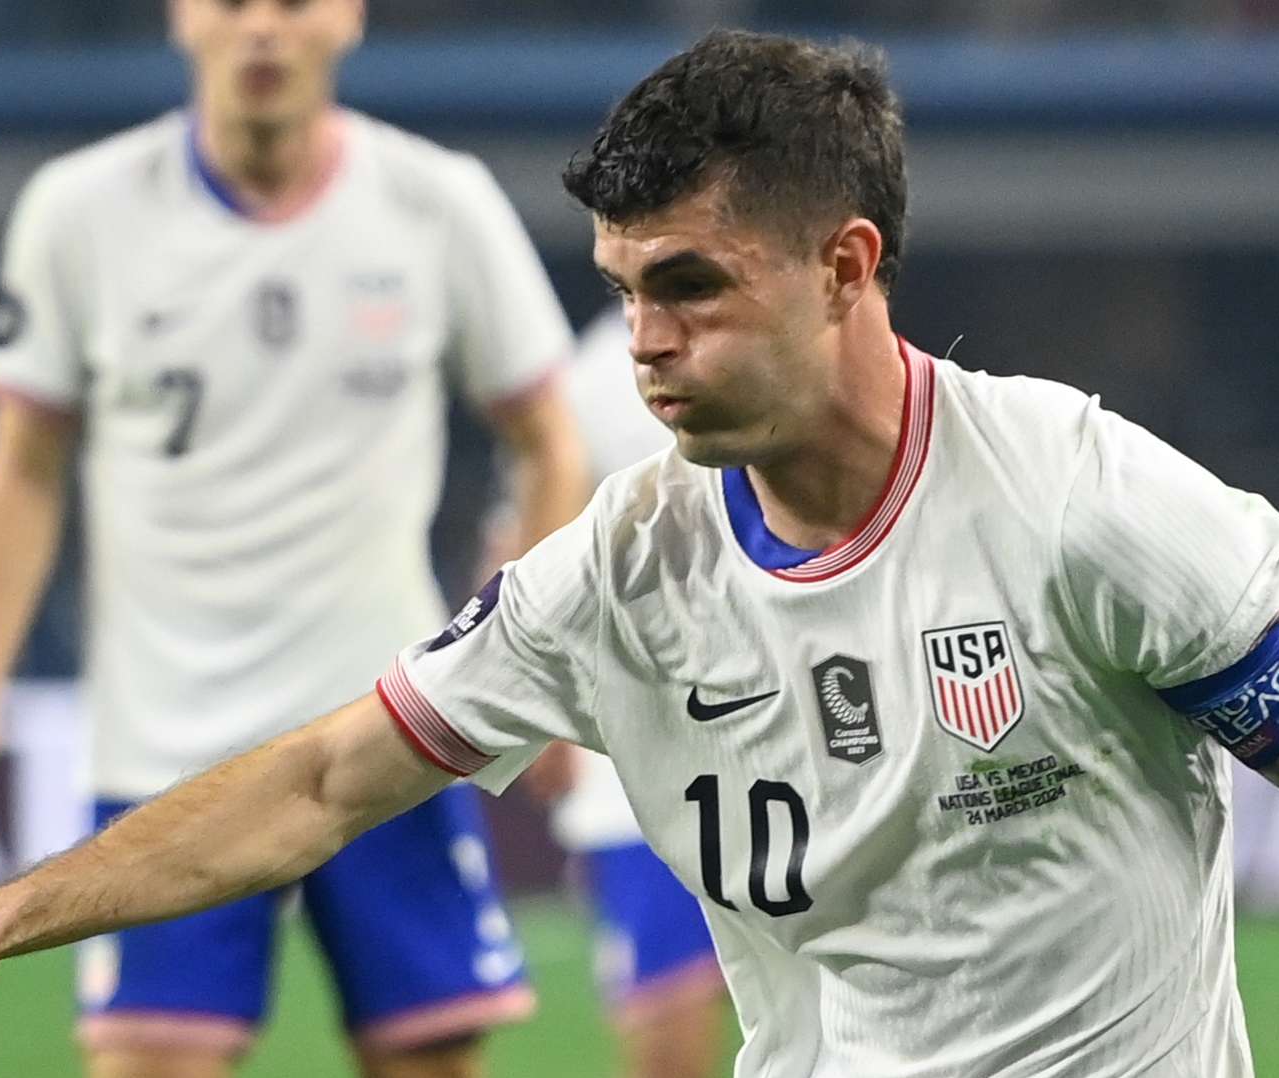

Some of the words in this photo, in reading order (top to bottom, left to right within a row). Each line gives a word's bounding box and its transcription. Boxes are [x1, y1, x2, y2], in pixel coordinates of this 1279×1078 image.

[154, 366, 205, 460] 7
[931, 630, 1006, 679] USA
[938, 791, 992, 811] NATIONS
[993, 777, 1043, 803] LEAGUE
[1046, 763, 1086, 785] FINAL
[955, 775, 982, 791] USA
[1007, 755, 1057, 780] MEXICO
[966, 810, 983, 825] 24
[984, 800, 1031, 823] MARCH
[1034, 784, 1066, 807] 2024
[685, 774, 814, 917] 10
